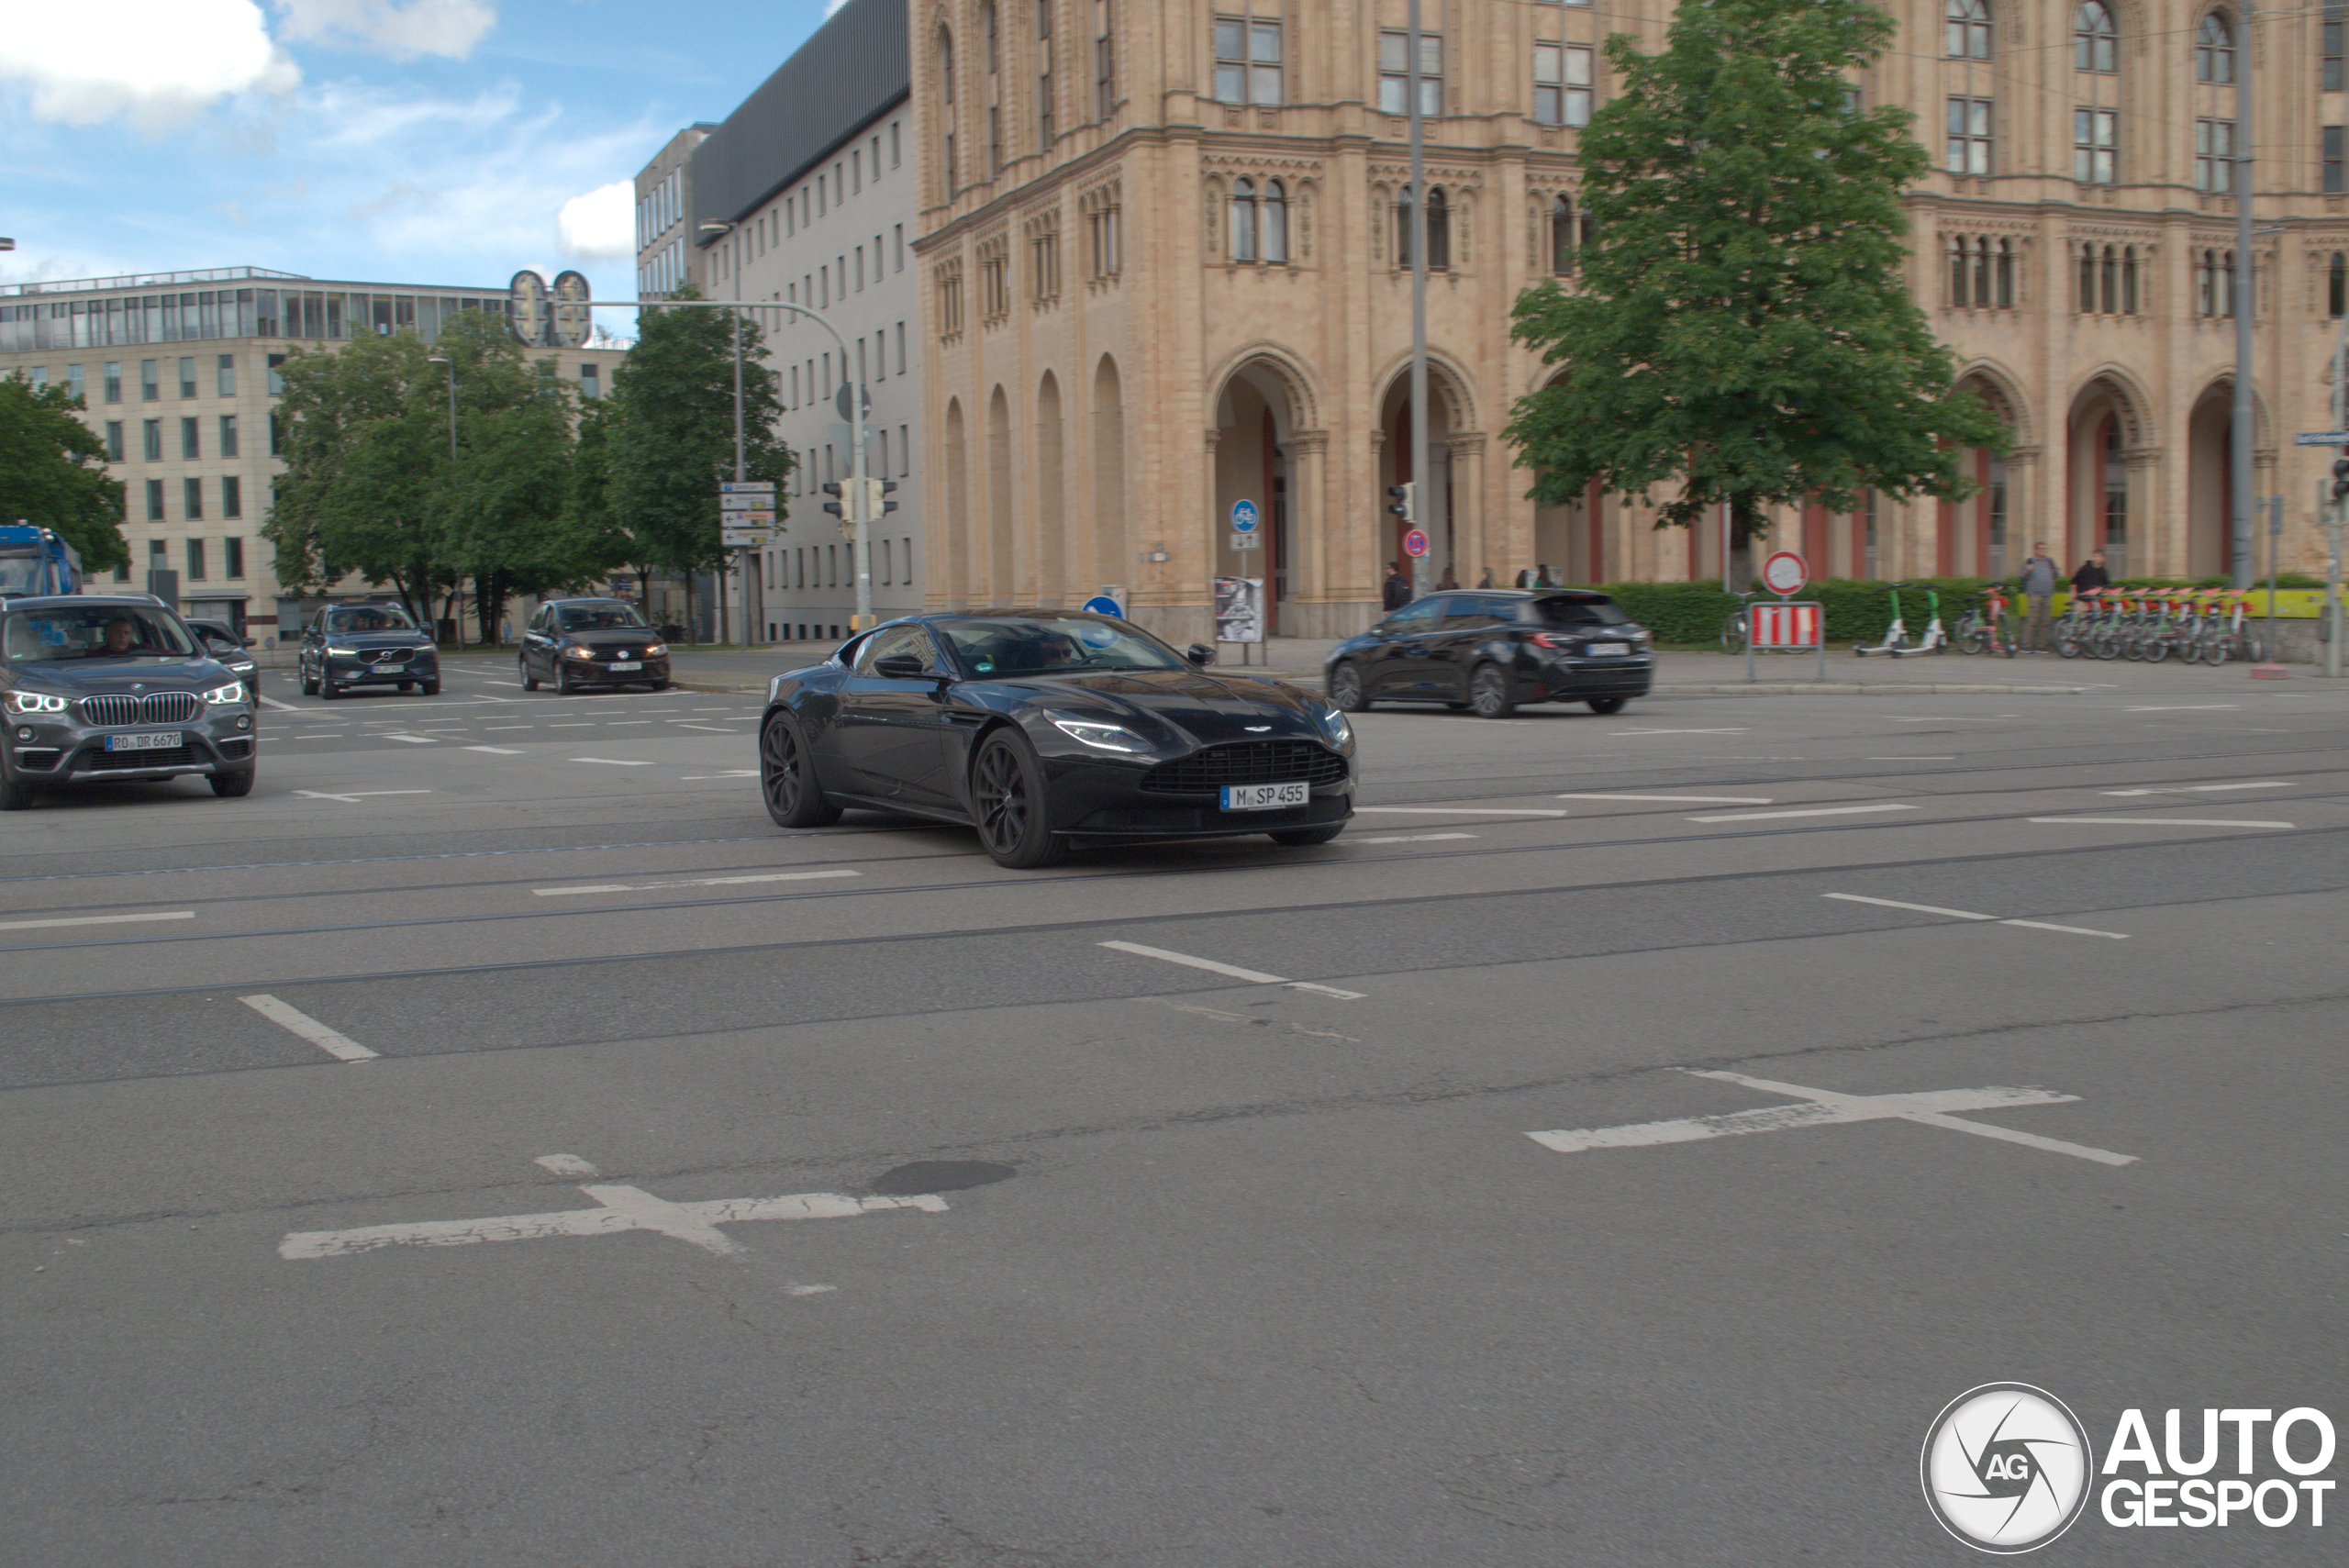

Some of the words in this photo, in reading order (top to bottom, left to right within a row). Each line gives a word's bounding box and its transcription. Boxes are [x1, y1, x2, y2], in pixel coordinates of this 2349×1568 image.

[114, 737, 128, 749] RO
[137, 735, 151, 748] DR
[153, 734, 181, 747] 6670
[1236, 789, 1247, 806] M
[1256, 787, 1275, 805] SP
[1277, 785, 1304, 803] 455
